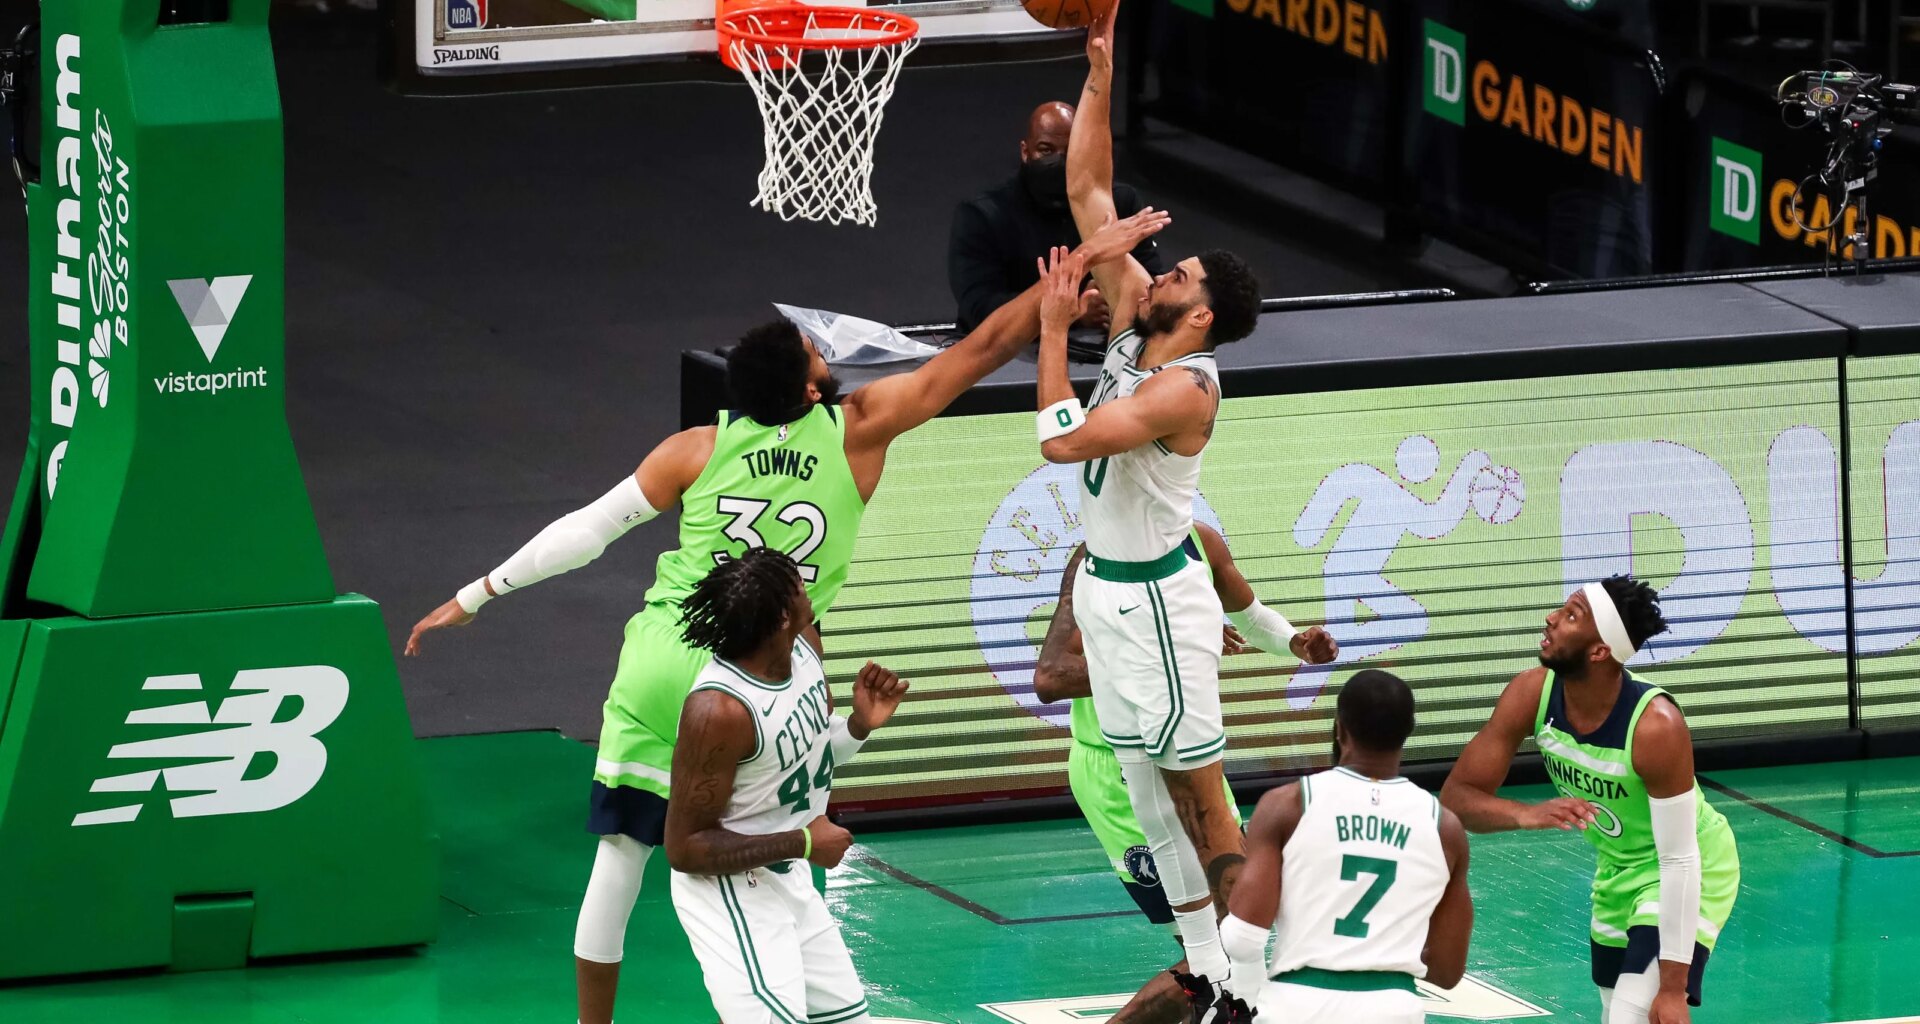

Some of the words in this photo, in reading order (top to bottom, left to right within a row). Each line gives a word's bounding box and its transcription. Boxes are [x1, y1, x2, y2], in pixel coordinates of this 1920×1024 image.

[451, 7, 472, 24] NBA
[1227, 0, 1388, 64] ARDEN
[433, 45, 499, 64] SPALDING
[1427, 38, 1462, 104] TD
[1472, 60, 1642, 184] GARDEN
[88, 108, 118, 316] Sports
[1716, 156, 1756, 222] TD
[115, 156, 129, 346] BOSTON
[154, 367, 267, 394] vistaprint
[1056, 408, 1073, 428] 0
[742, 448, 818, 481] TOWNS
[711, 495, 827, 583] 32
[1560, 419, 1920, 665] DU
[777, 739, 834, 815] 44
[1336, 815, 1411, 850] BROWN
[1333, 854, 1398, 938] 7
